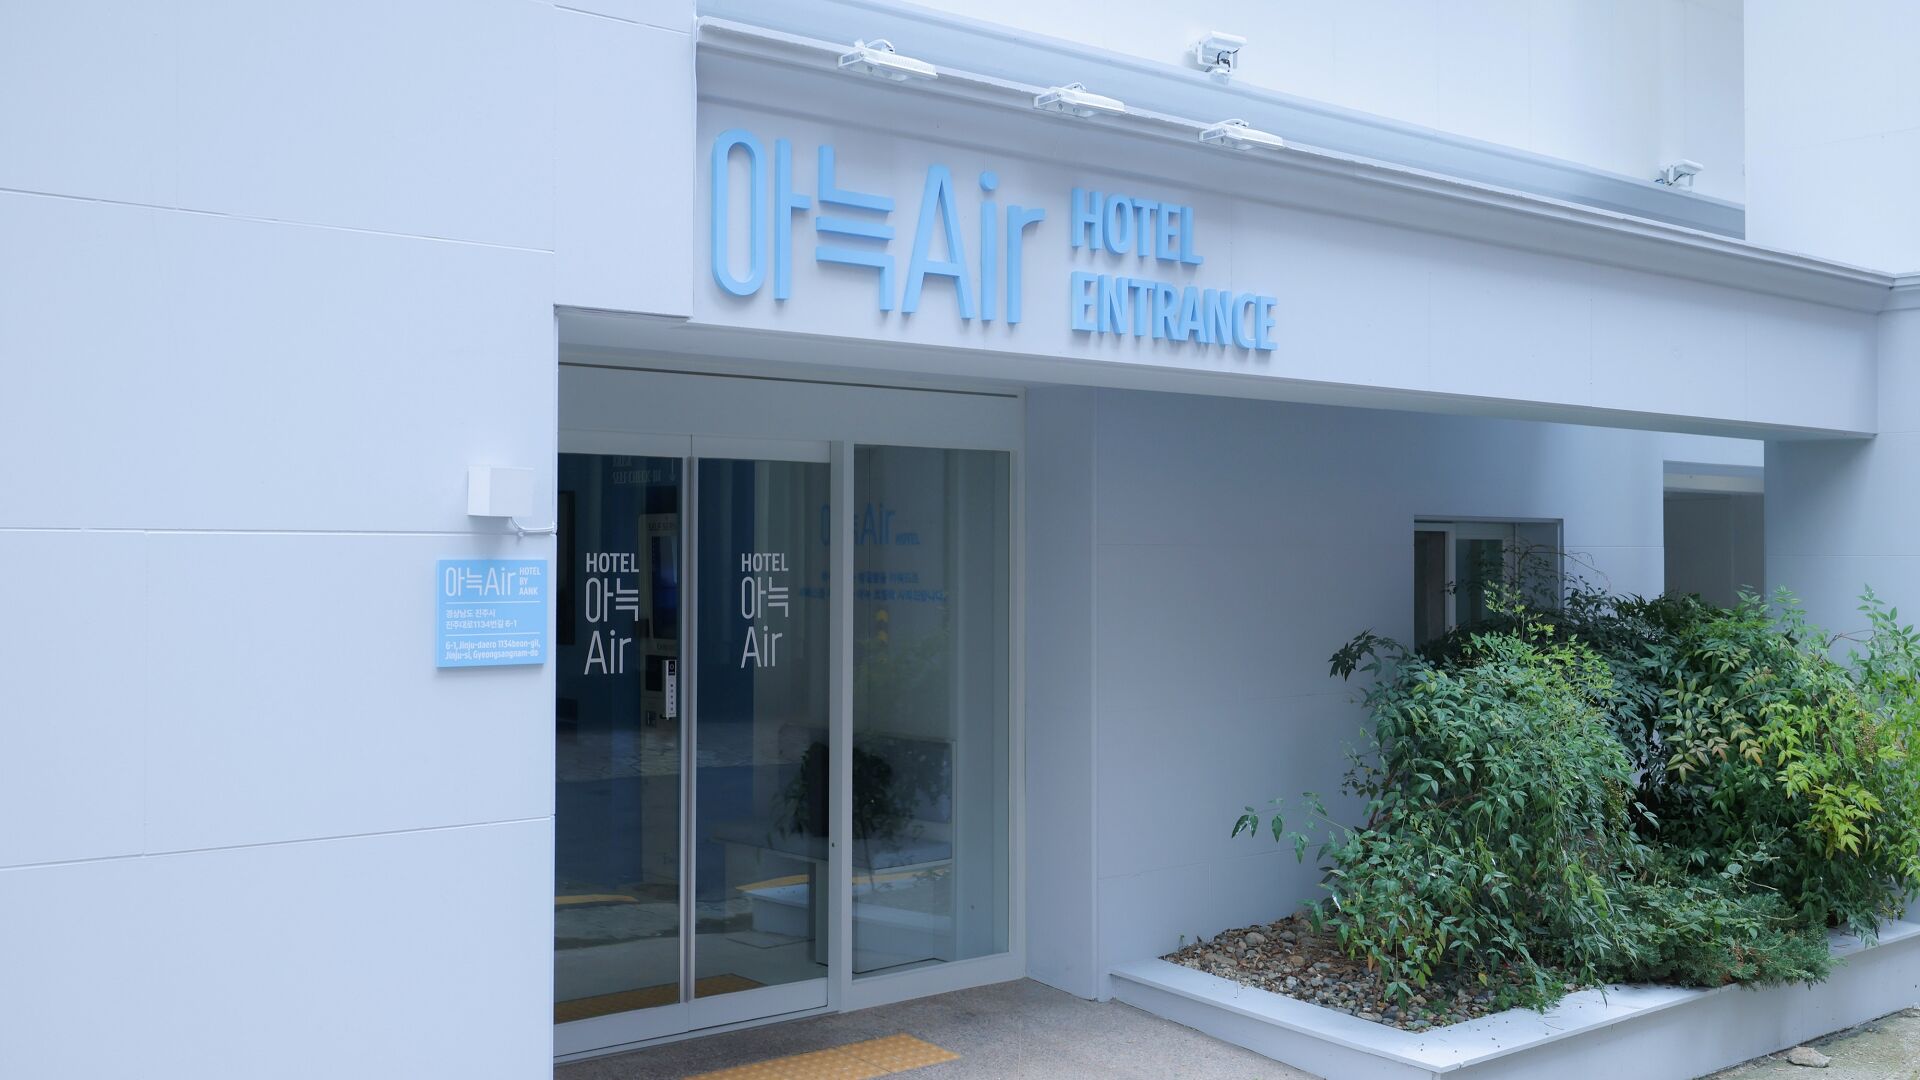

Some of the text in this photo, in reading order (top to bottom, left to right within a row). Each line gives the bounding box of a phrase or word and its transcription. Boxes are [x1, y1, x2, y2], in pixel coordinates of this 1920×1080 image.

[1070, 188, 1203, 266] HOTEL
[1070, 270, 1278, 352] ENTRANCE
[519, 567, 541, 576] HOTEL
[519, 576, 529, 585] BY
[586, 553, 639, 573] HOTEL
[741, 553, 789, 572] HOTEL
[475, 608, 497, 618] 진주시
[585, 577, 639, 623] 아늑
[741, 576, 789, 620] 아늑
[584, 629, 632, 675] Air
[740, 625, 783, 669] Air
